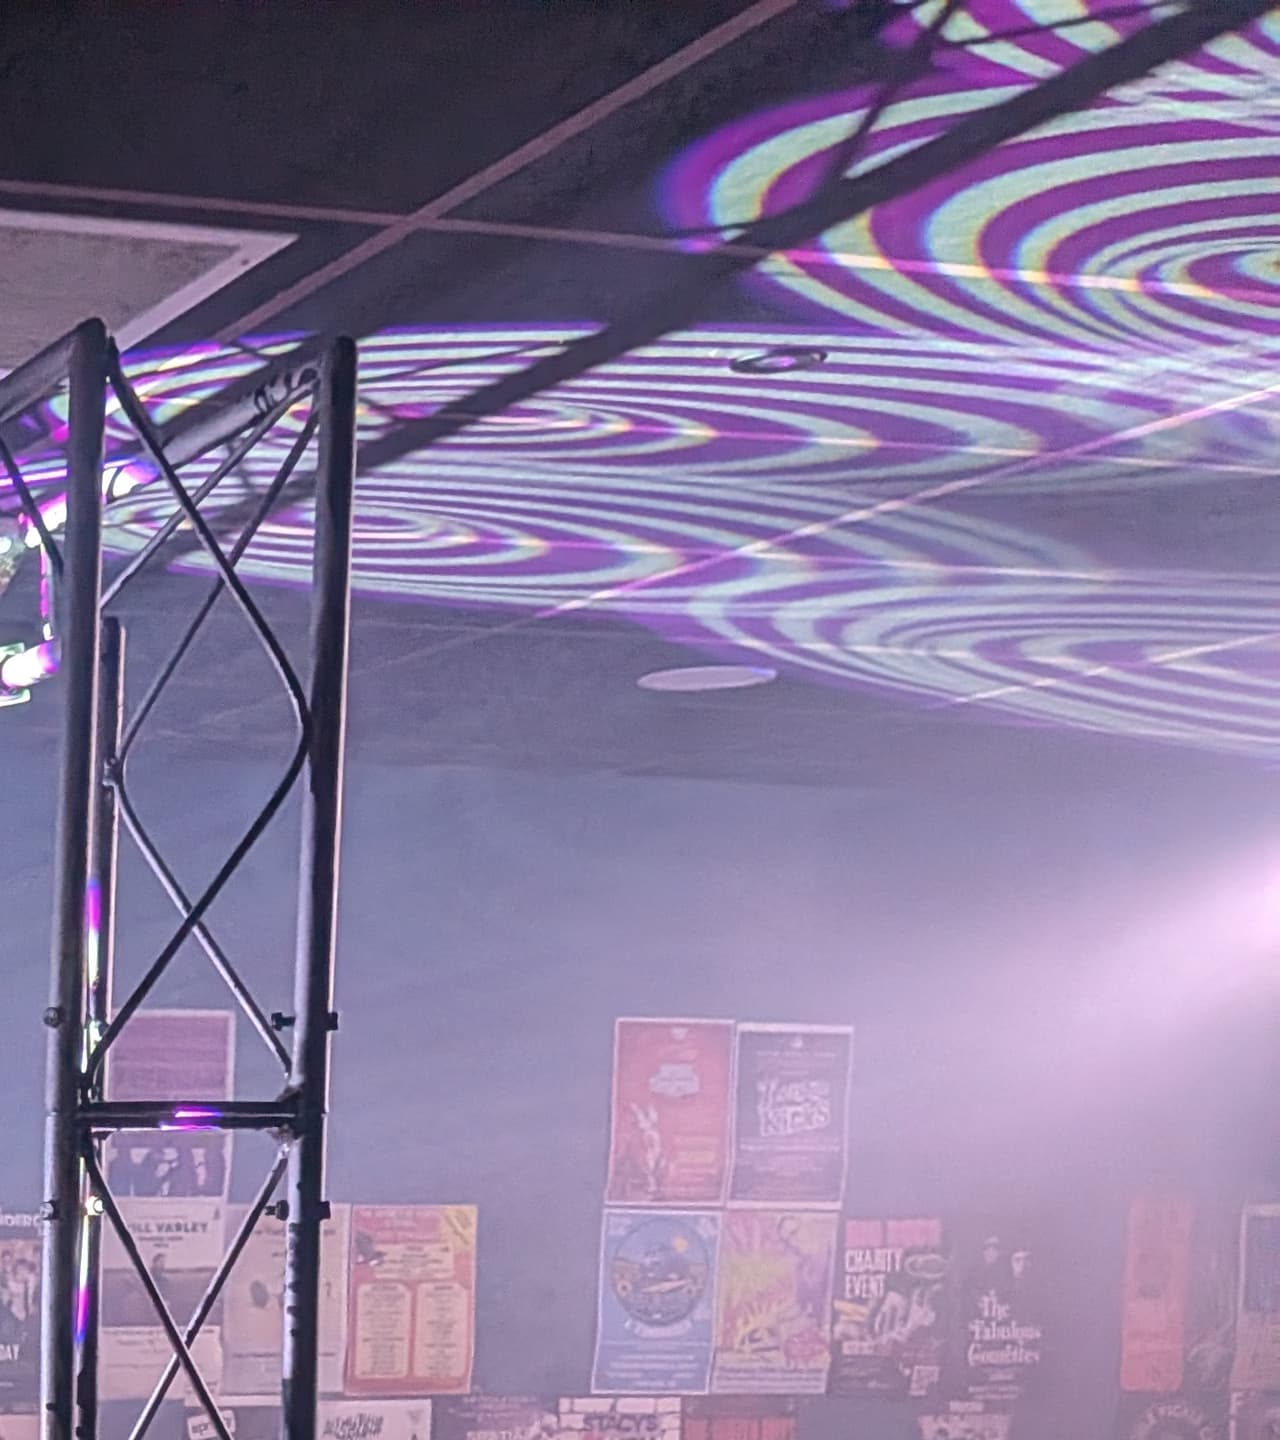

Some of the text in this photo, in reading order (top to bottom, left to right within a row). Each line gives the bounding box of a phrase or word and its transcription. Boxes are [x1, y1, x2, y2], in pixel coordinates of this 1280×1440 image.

[155, 1222, 209, 1233] VARLEY
[845, 1248, 904, 1273] CHARITY
[845, 1274, 887, 1299] EVENT
[981, 1290, 1011, 1320] The
